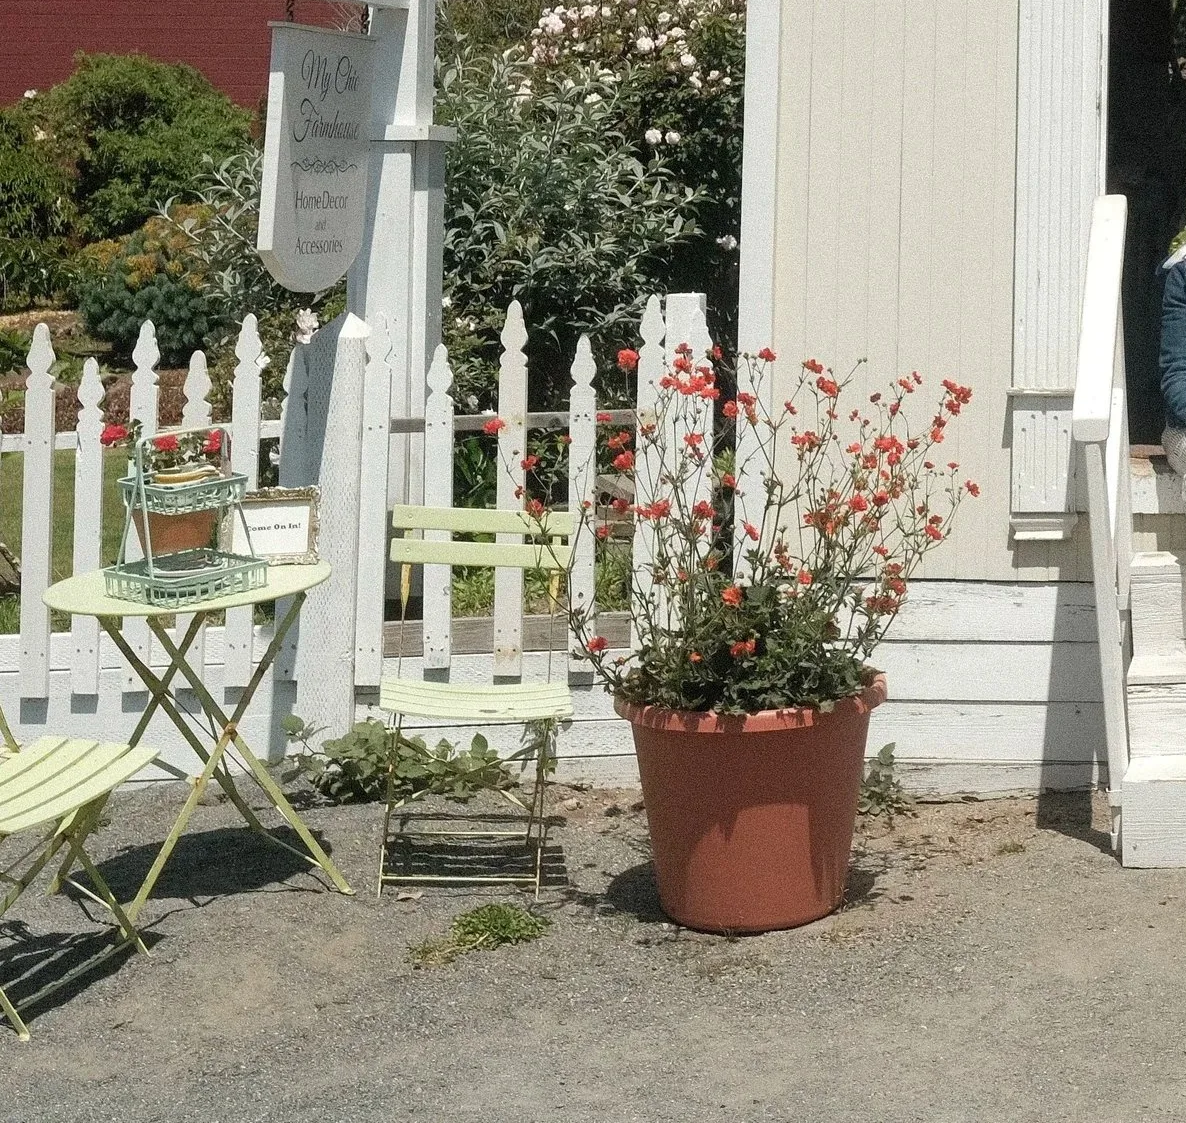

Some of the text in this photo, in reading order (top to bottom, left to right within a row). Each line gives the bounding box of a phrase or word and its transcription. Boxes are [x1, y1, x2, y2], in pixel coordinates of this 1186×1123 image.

[302, 50, 359, 101] My Chic
[293, 98, 360, 143] Farmhouse
[295, 191, 348, 209] Home Decor
[315, 216, 327, 231] and
[295, 235, 343, 255] Accessories
